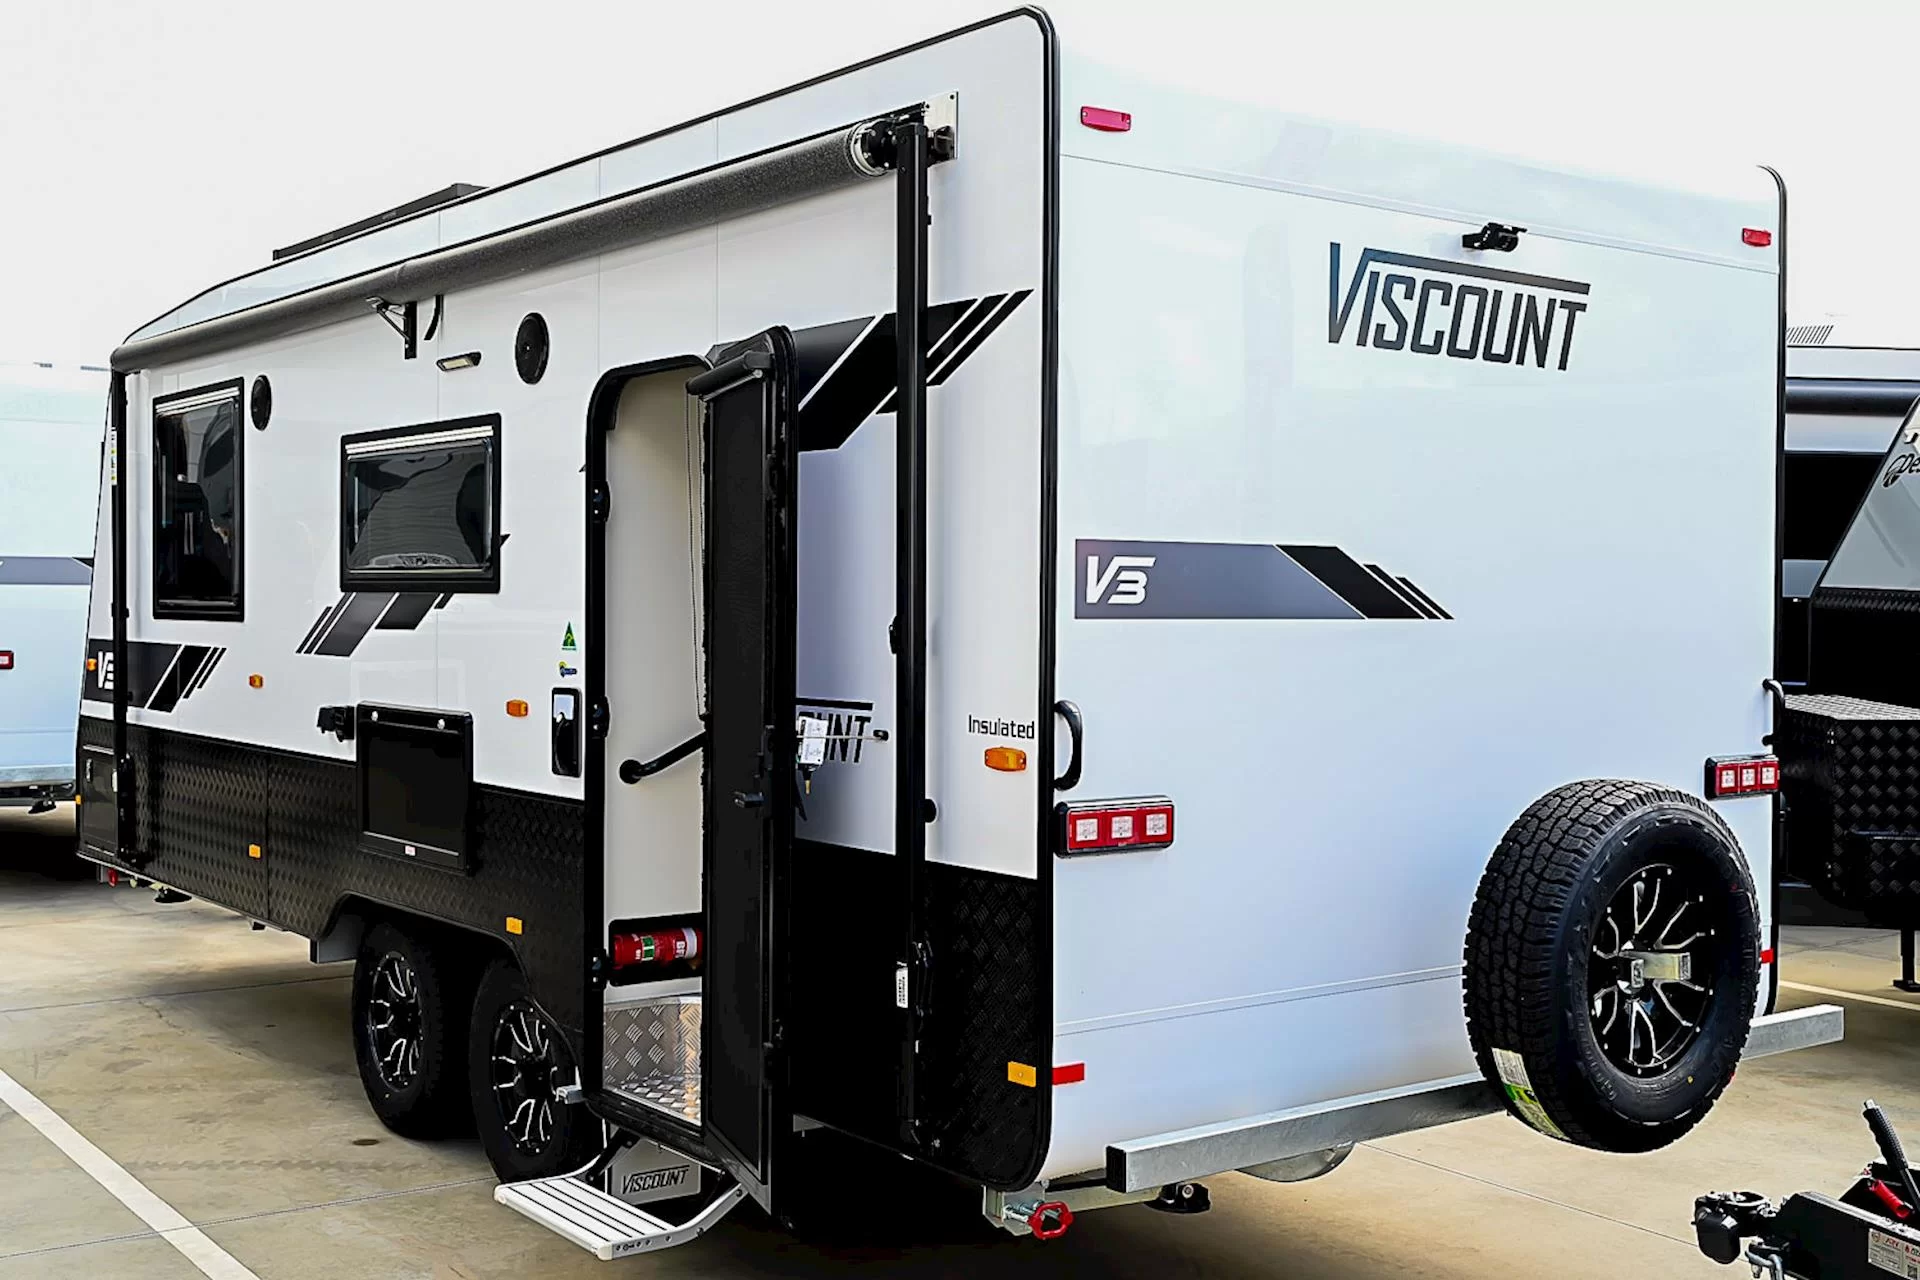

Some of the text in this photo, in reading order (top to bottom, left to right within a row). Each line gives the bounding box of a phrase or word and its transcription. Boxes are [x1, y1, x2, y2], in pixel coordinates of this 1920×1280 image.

[1328, 241, 1591, 372] VISCOUNT
[1086, 555, 1156, 604] V3
[968, 714, 1035, 740] Insulated
[622, 1164, 691, 1195] VISCOUNT
